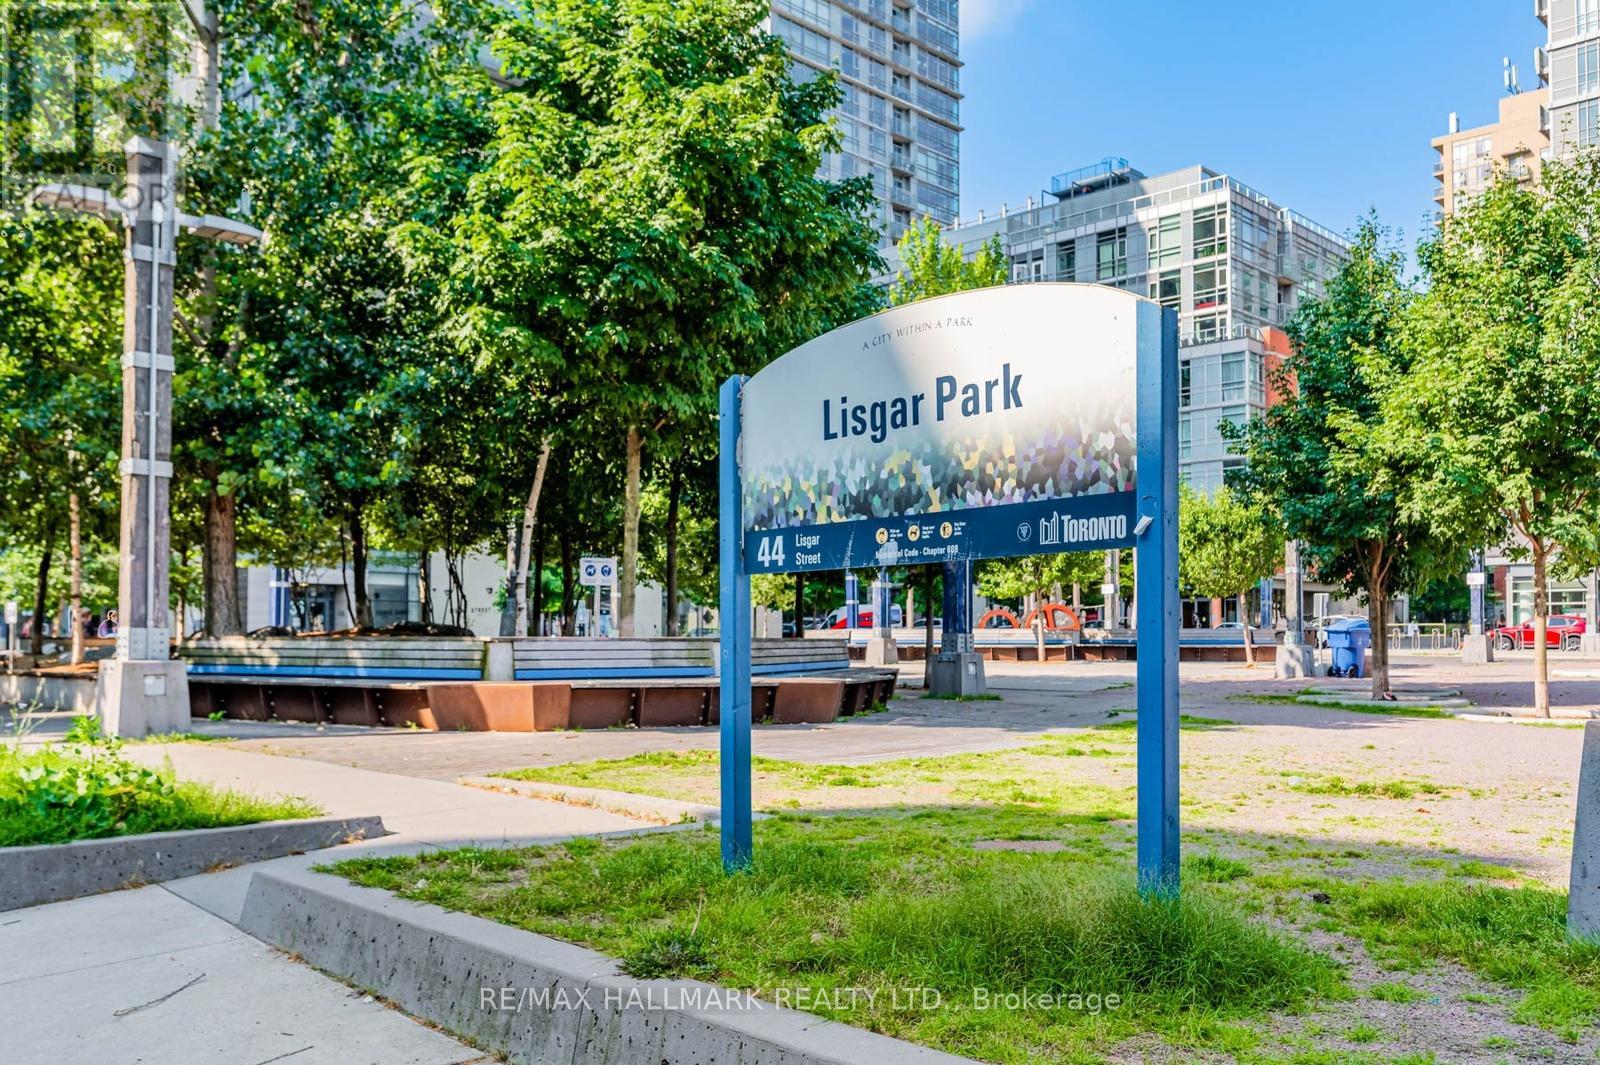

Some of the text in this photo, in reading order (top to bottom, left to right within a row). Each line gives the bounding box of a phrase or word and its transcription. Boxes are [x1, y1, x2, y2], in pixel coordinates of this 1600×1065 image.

[862, 316, 974, 351] A CITY WITHIN A PARK
[823, 363, 1023, 443] Lisgar Park
[795, 533, 820, 549] Lisgar
[1061, 514, 1127, 543] TORONTO
[757, 535, 786, 567] 44
[795, 552, 821, 565] Street
[904, 547, 918, 557] Code
[923, 546, 946, 556] Chapter
